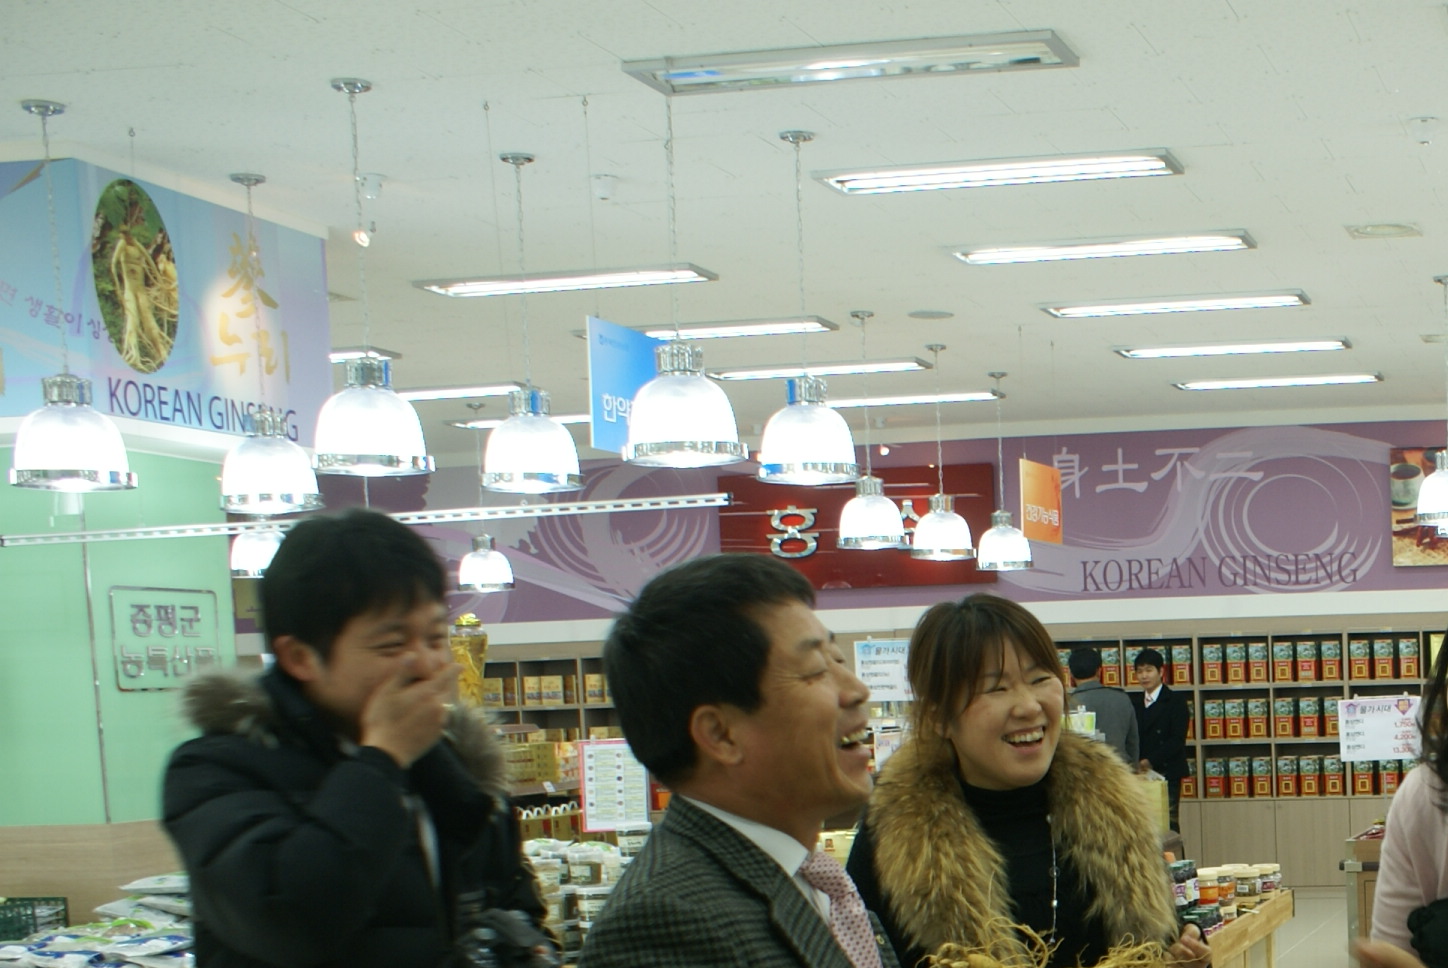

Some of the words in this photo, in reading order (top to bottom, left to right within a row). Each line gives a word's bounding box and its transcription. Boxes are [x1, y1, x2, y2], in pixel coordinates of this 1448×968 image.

[107, 376, 202, 427] KOREAN
[602, 393, 633, 424] 한약
[1080, 556, 1207, 592] KOREAN
[1217, 552, 1358, 587] GINSENG
[129, 604, 201, 638] 증평군
